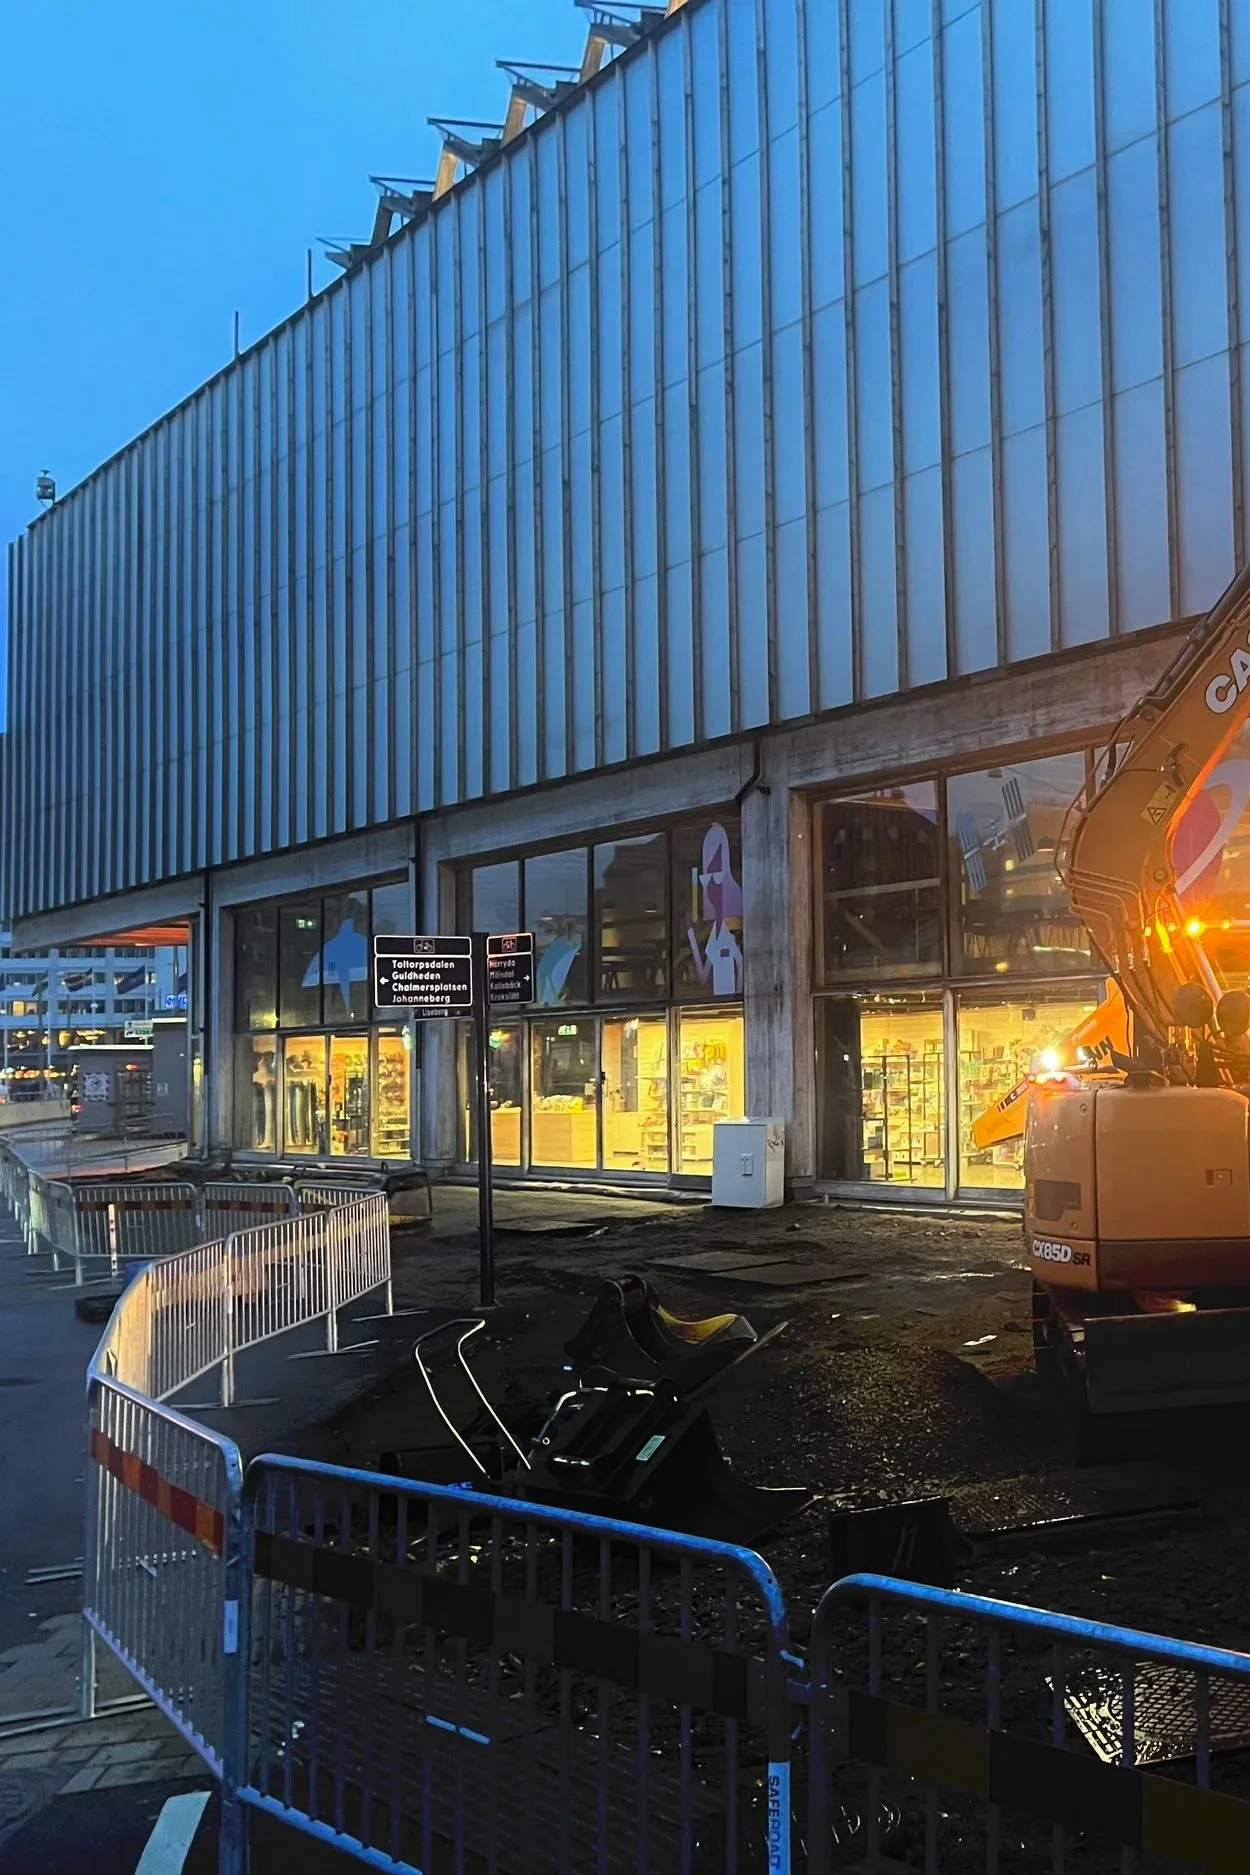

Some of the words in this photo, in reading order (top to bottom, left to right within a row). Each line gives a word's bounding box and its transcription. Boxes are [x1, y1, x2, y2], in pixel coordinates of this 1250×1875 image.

[391, 960, 455, 971] Toltorpsdalen
[391, 971, 441, 981] Guldheden
[391, 982, 468, 993] Chalmersplatsen
[392, 994, 451, 1004] Johanneberg
[422, 1008, 449, 1017] Liseberg
[1032, 1239, 1073, 1263] CX85D
[1072, 1251, 1091, 1266] SR
